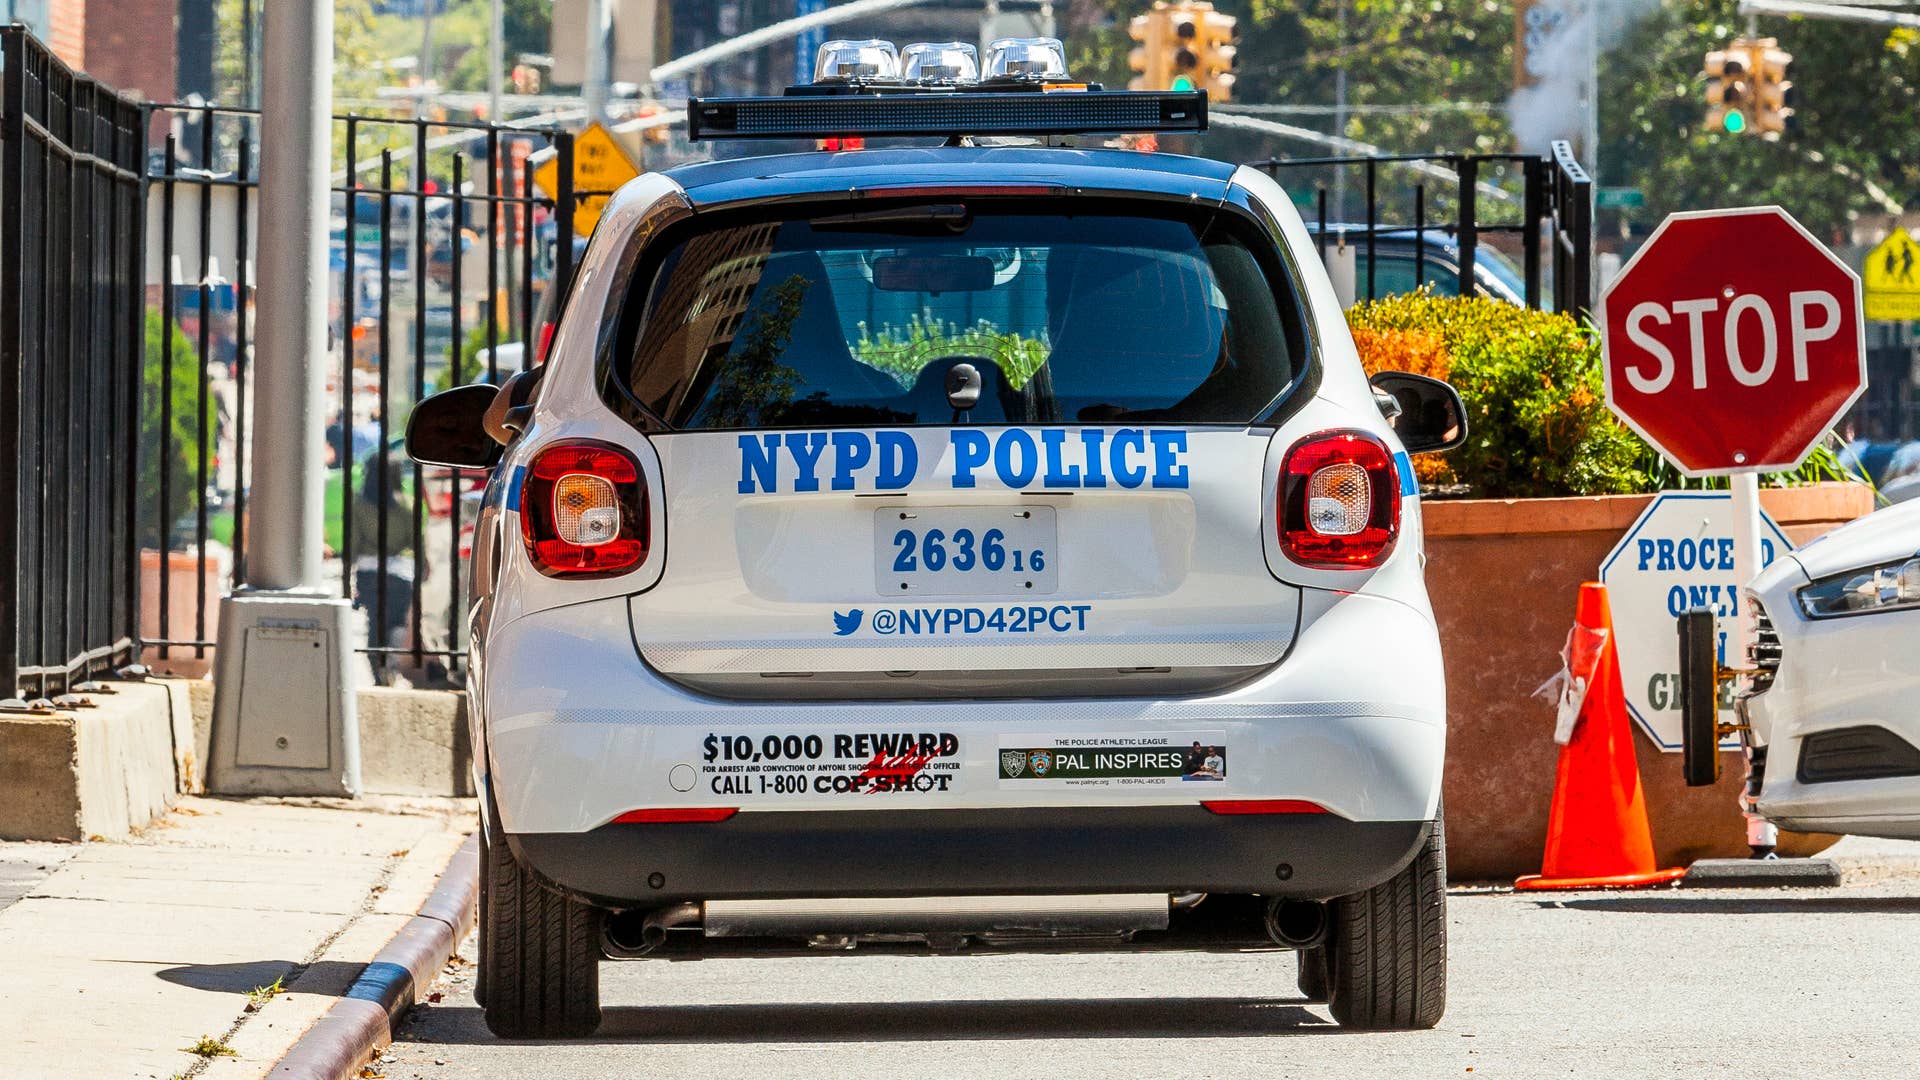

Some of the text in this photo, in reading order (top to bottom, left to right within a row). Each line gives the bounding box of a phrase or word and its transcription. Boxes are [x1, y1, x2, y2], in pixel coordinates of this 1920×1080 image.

[1624, 290, 1842, 394] STOP
[737, 428, 1189, 494] NYPD POLICE
[893, 528, 1045, 572] 2636 16
[1638, 538, 1775, 571] PROCED
[872, 605, 1091, 635] @NYPD42PCT
[703, 732, 959, 763] $10,000 REWARD
[1100, 738, 1136, 746] ATHLETIC
[718, 765, 744, 773] ARREST
[762, 764, 805, 772] CONVICTION
[818, 764, 846, 772] ANYONE
[933, 762, 961, 770] OFFICER
[1056, 753, 1183, 770] PAL INSPIRES
[711, 773, 953, 794] CALL 1-800 COP-SHOT
